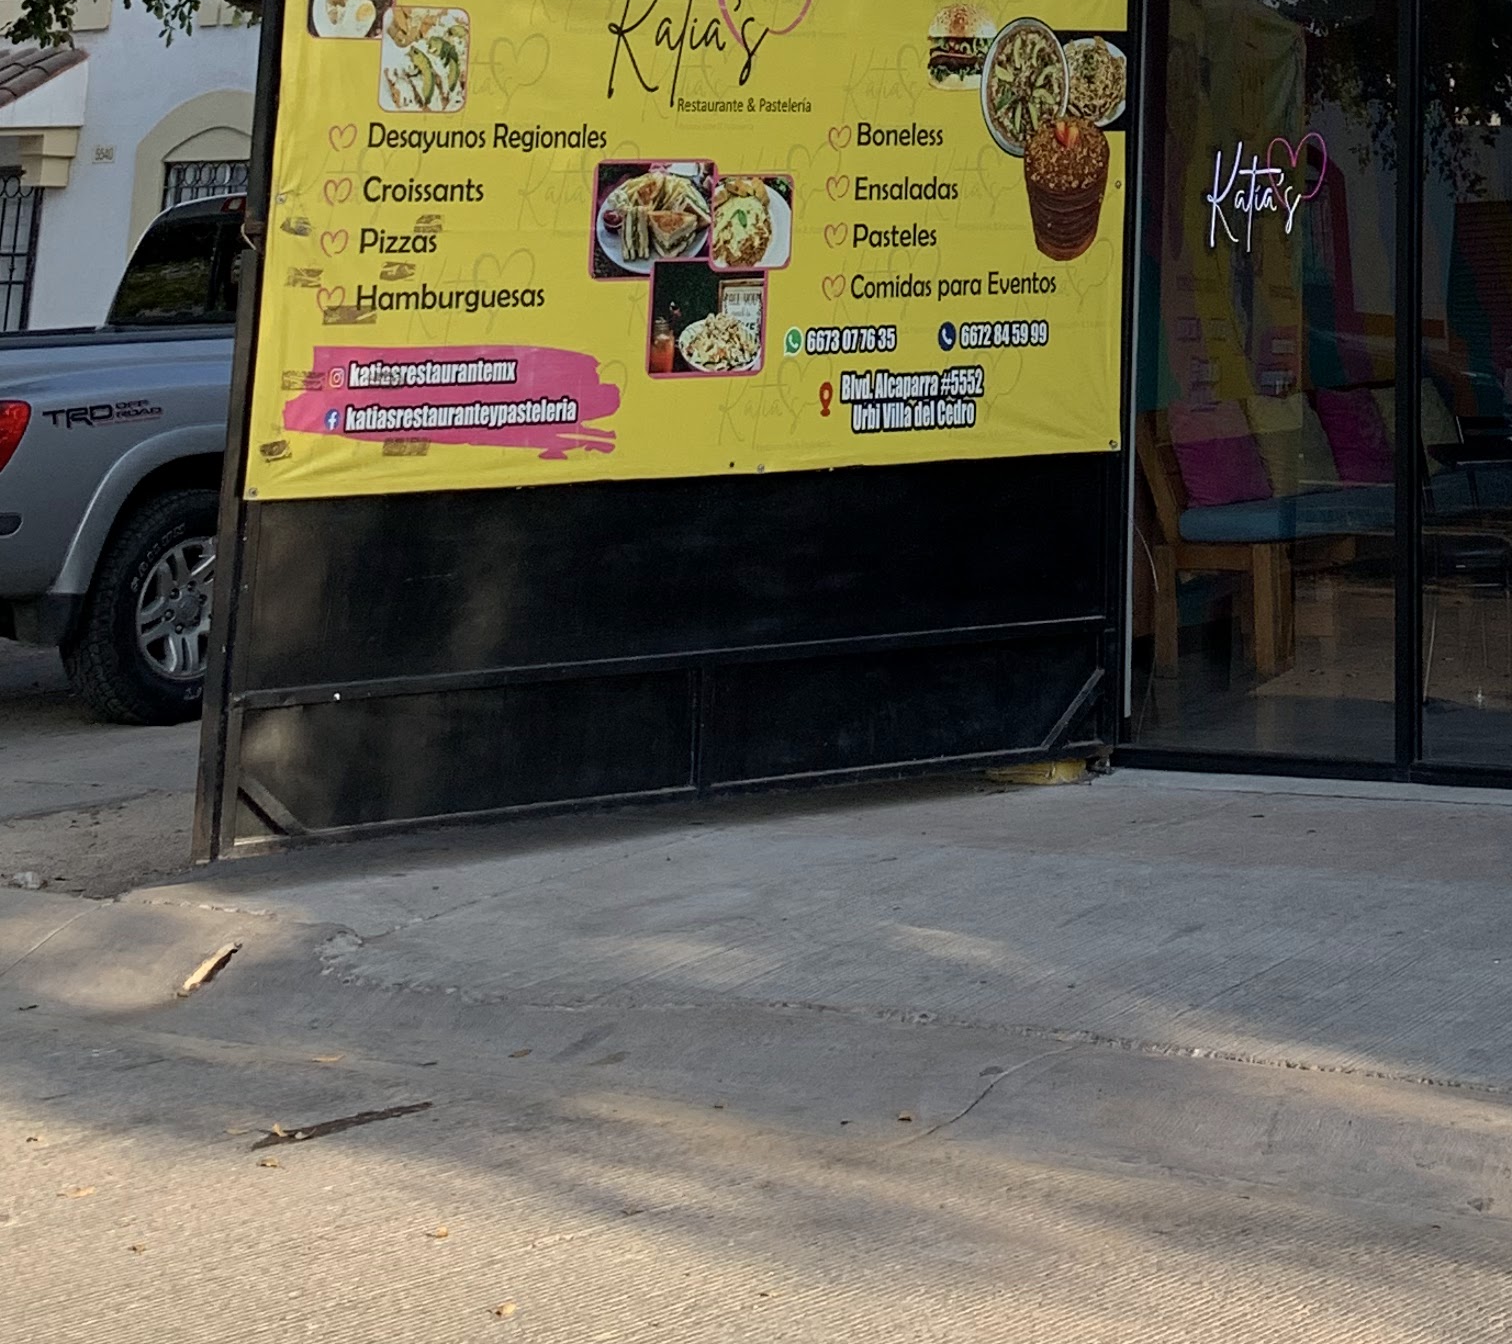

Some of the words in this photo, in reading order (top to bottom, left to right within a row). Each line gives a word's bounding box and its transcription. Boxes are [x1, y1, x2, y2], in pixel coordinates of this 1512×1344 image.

[677, 97, 744, 113] Restaurante
[747, 97, 755, 112] &
[759, 96, 812, 113] Pastelería
[367, 122, 486, 154] Desayunos
[493, 123, 607, 153] Regionales
[857, 122, 943, 146] Boneless
[363, 176, 484, 202] Croissants
[854, 176, 959, 200] Ensaladas
[1207, 141, 1301, 252] Katia's
[359, 228, 437, 254] Pizzas
[852, 223, 937, 248] Pasteles
[356, 283, 545, 313] Hamburguesas
[850, 273, 932, 299] Comidas
[937, 278, 982, 301] para
[988, 271, 1057, 295] Eventos
[806, 329, 840, 353] 6673
[841, 328, 859, 351] 07
[860, 327, 877, 351] 76
[878, 327, 896, 350] 35
[961, 323, 992, 347] 6672
[994, 323, 1010, 345] 84
[1011, 322, 1029, 345] 59
[1030, 321, 1047, 344] 99
[349, 361, 516, 387] katiasrestaurantemx
[841, 373, 873, 400] Blvd.
[875, 372, 939, 400] Alcaparra
[940, 368, 983, 395] #5552
[42, 404, 113, 429] TRD
[115, 399, 149, 410] OFF
[116, 407, 163, 419] ROAD
[345, 398, 578, 431] katiasrestauranteypasteleria
[852, 402, 880, 431] Urbi
[882, 402, 912, 429] Villa
[914, 400, 935, 427] del
[937, 398, 975, 426] Cedro
